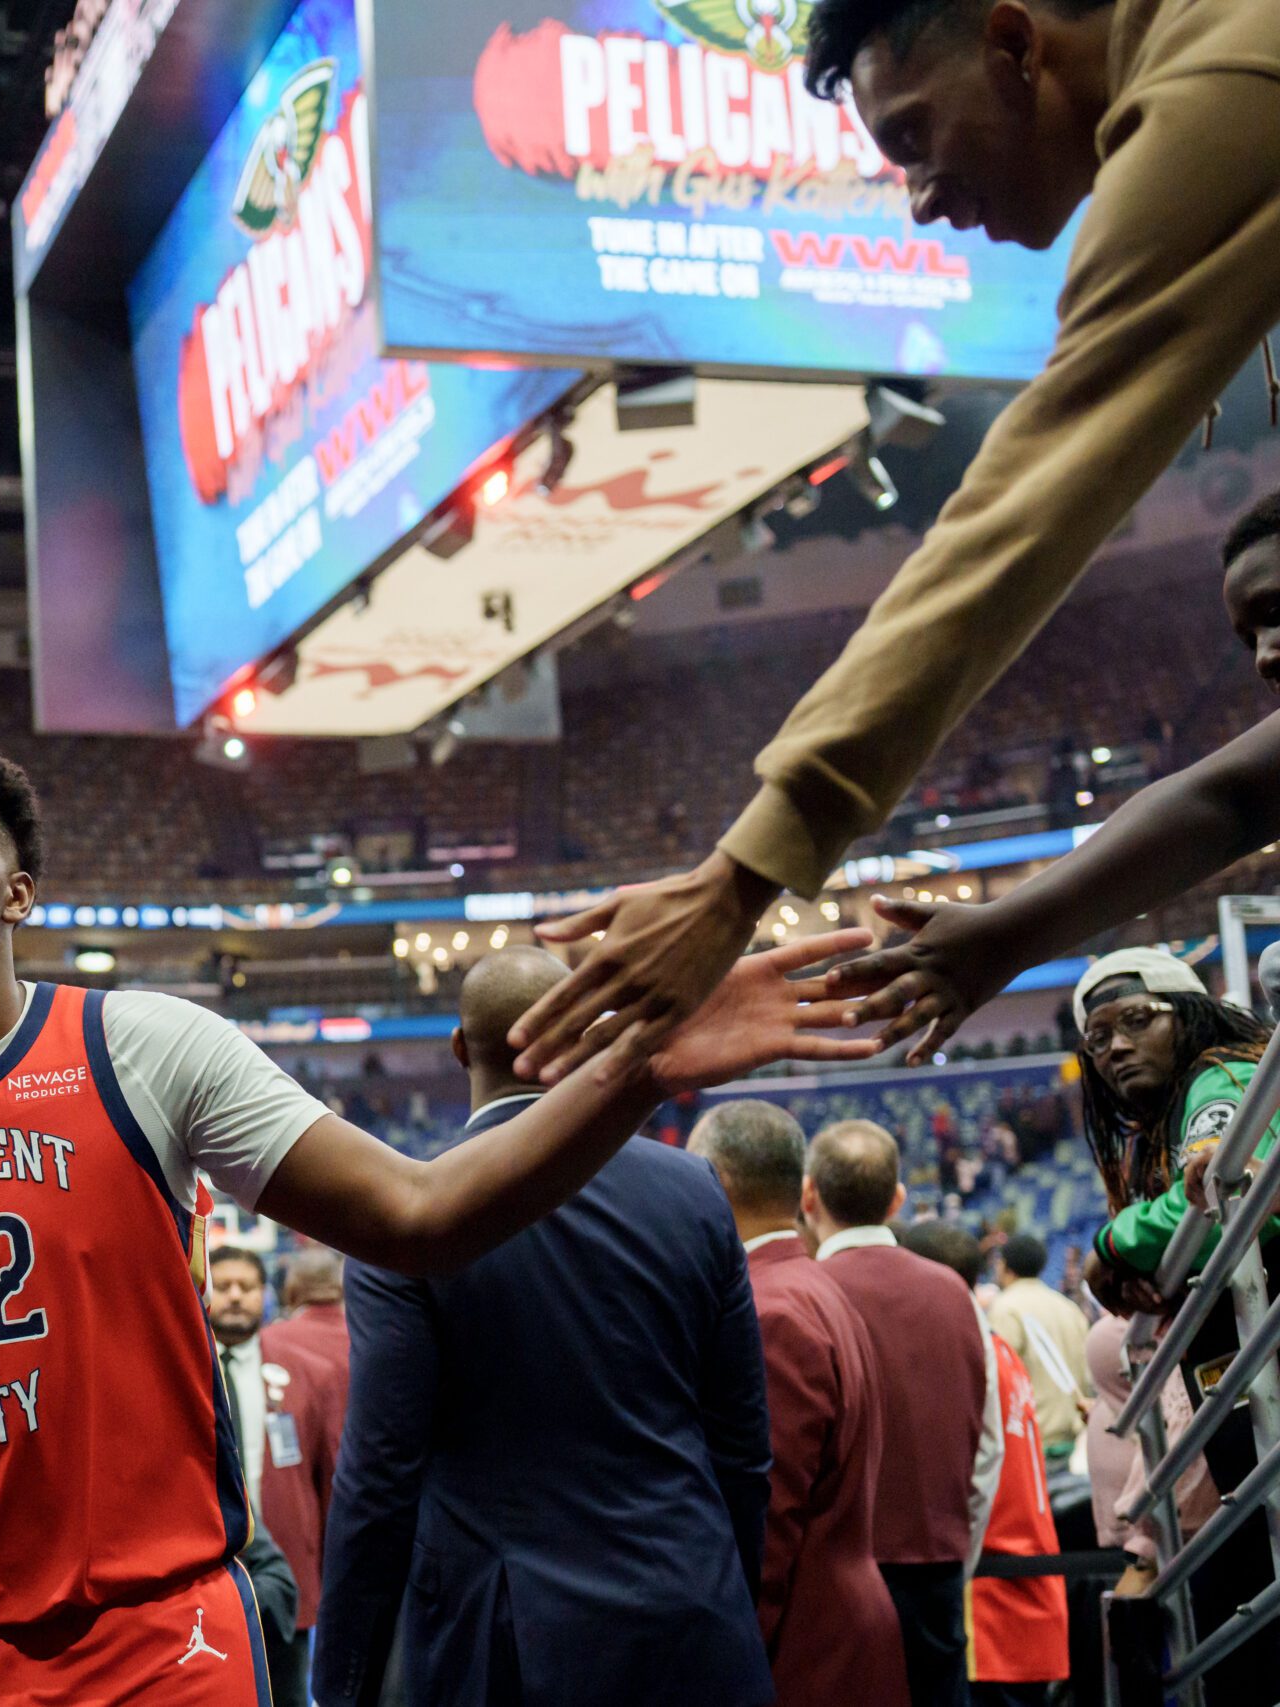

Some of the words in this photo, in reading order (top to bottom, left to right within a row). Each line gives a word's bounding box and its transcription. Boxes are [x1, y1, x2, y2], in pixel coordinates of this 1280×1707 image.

[559, 33, 884, 178] PELICANS
[688, 224, 764, 262] AFTER
[770, 229, 970, 278] WWL
[597, 255, 649, 292] THE
[648, 257, 720, 297] GAME
[720, 262, 760, 299] ON
[8, 1066, 87, 1091] NEWAGE
[15, 1084, 80, 1101] PRODUCTS
